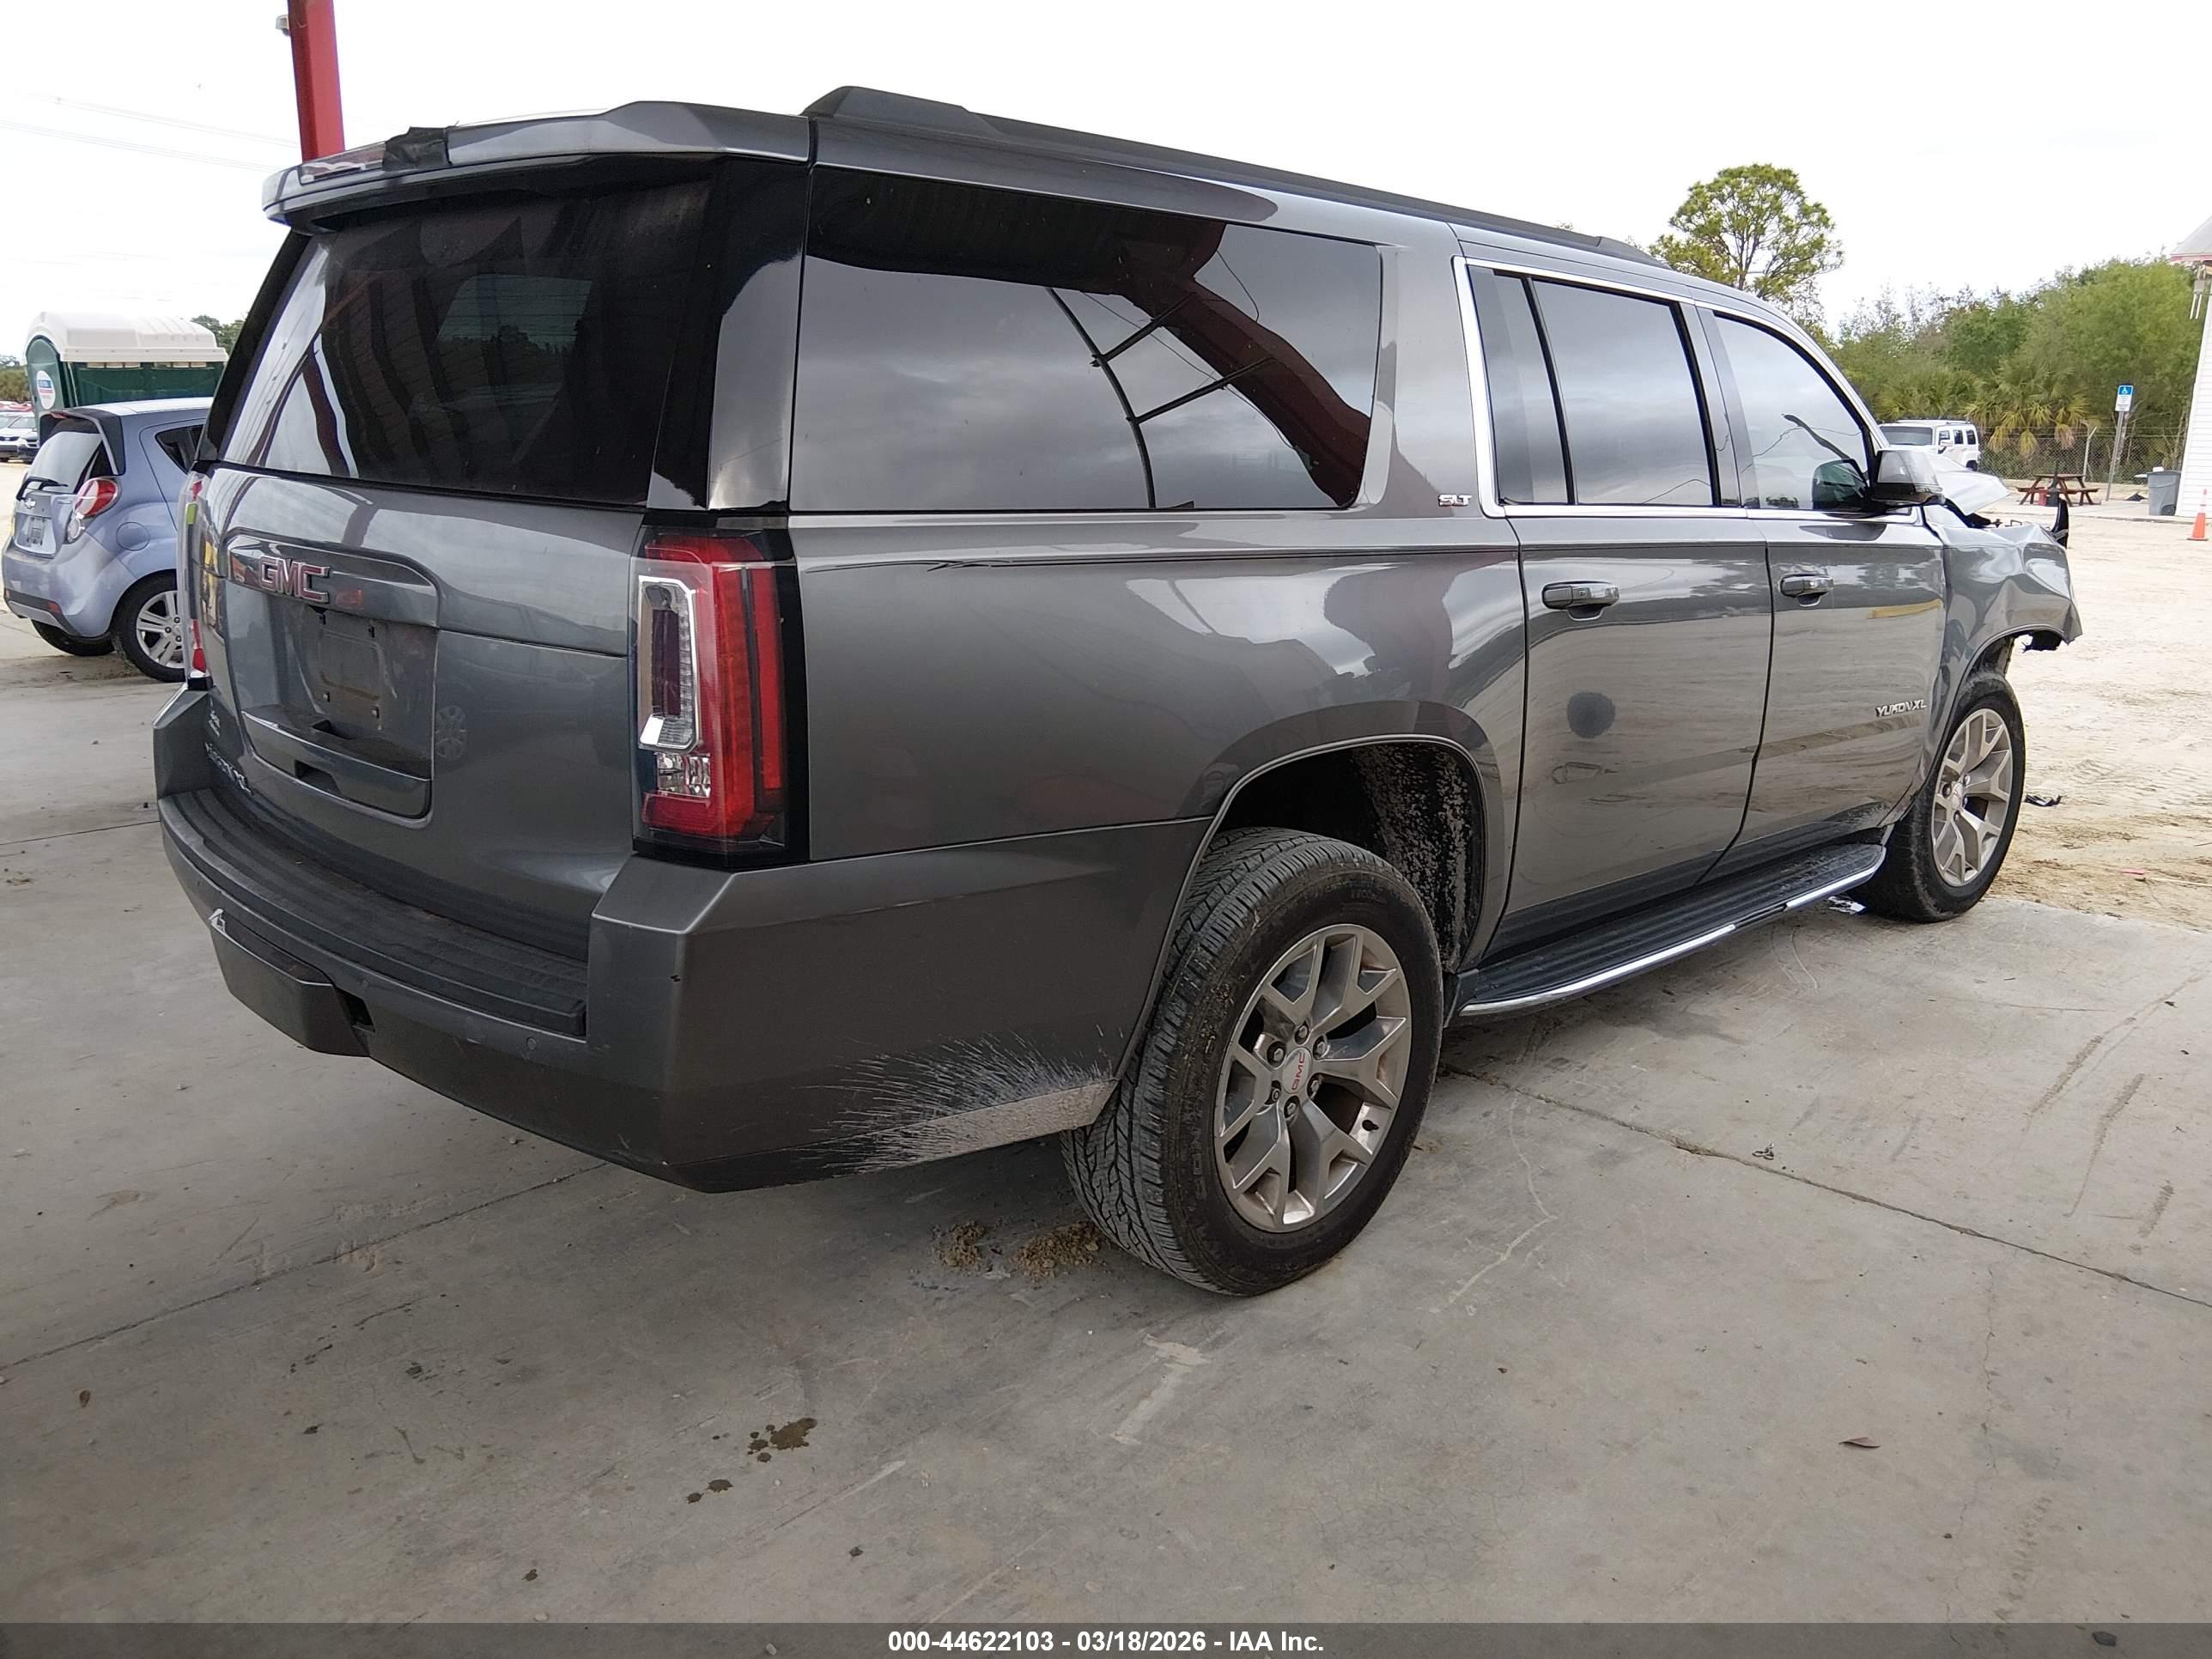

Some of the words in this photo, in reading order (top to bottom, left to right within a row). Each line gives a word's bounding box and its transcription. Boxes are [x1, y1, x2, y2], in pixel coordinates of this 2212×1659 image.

[1437, 494, 1472, 507] SLT
[259, 555, 330, 604] GMC
[1291, 1051, 1306, 1091] GMC
